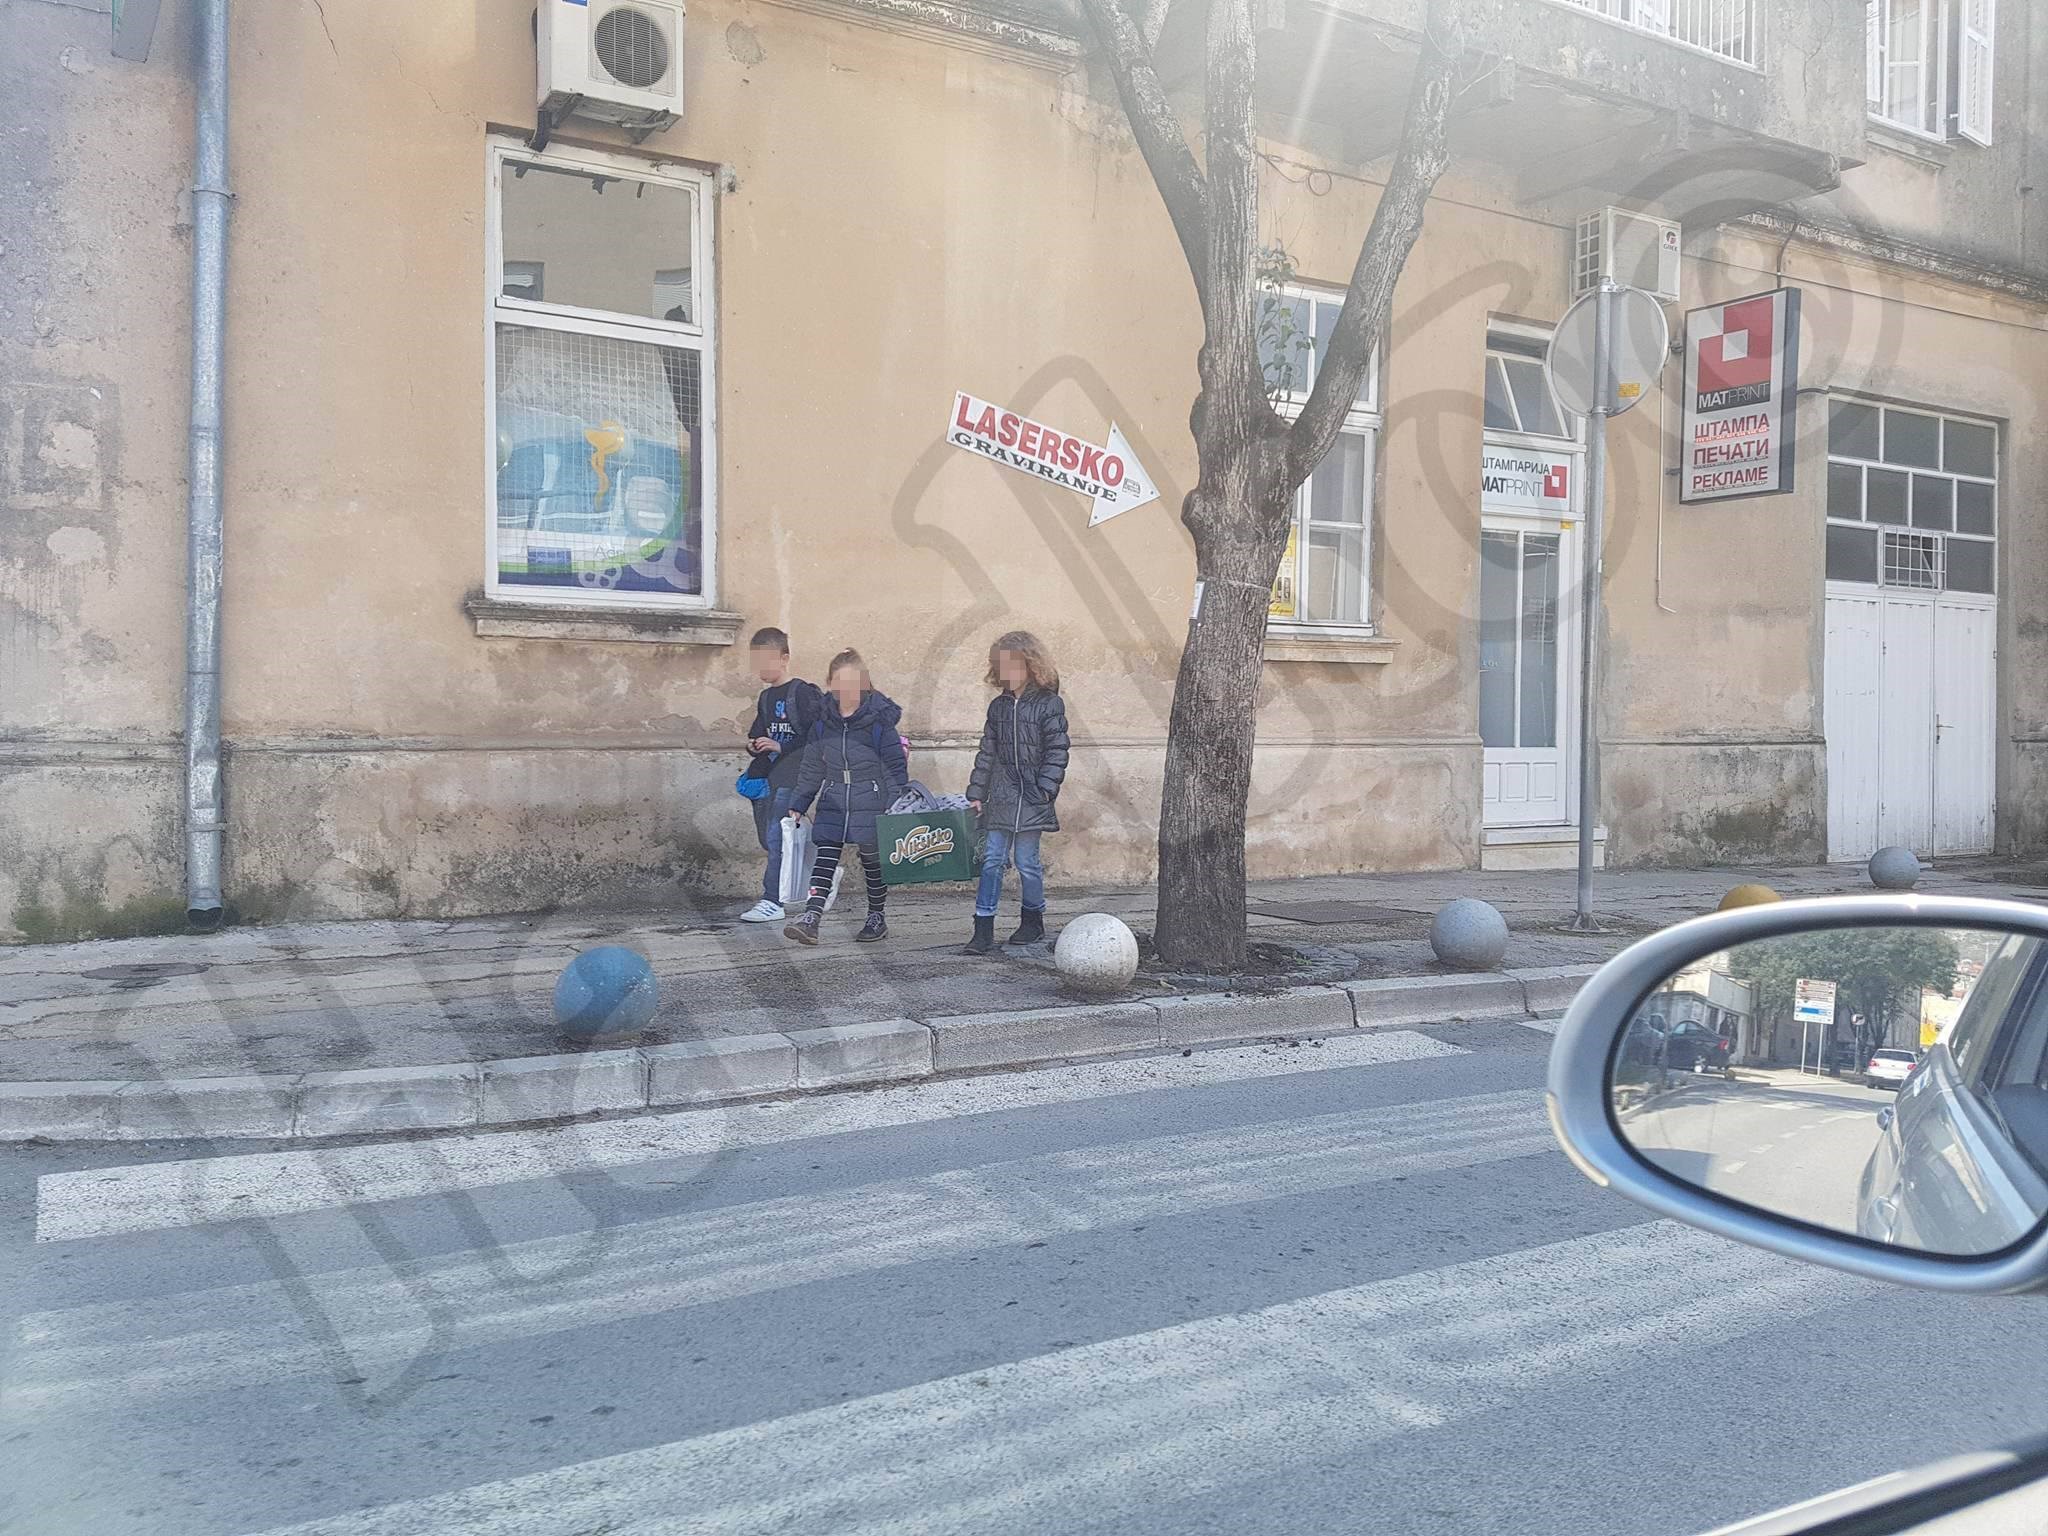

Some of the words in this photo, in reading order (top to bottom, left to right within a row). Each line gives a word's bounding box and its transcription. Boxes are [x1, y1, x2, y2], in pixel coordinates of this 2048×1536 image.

[1698, 382, 1769, 409] MATPRINT
[1695, 413, 1770, 439] ШТАМПА
[955, 395, 1125, 487] LASERSKO
[1693, 438, 1769, 465] ПЕЧАТИ
[954, 432, 1118, 503] GRAVIRANJE
[1692, 466, 1769, 489] РЕКЛАМЕ
